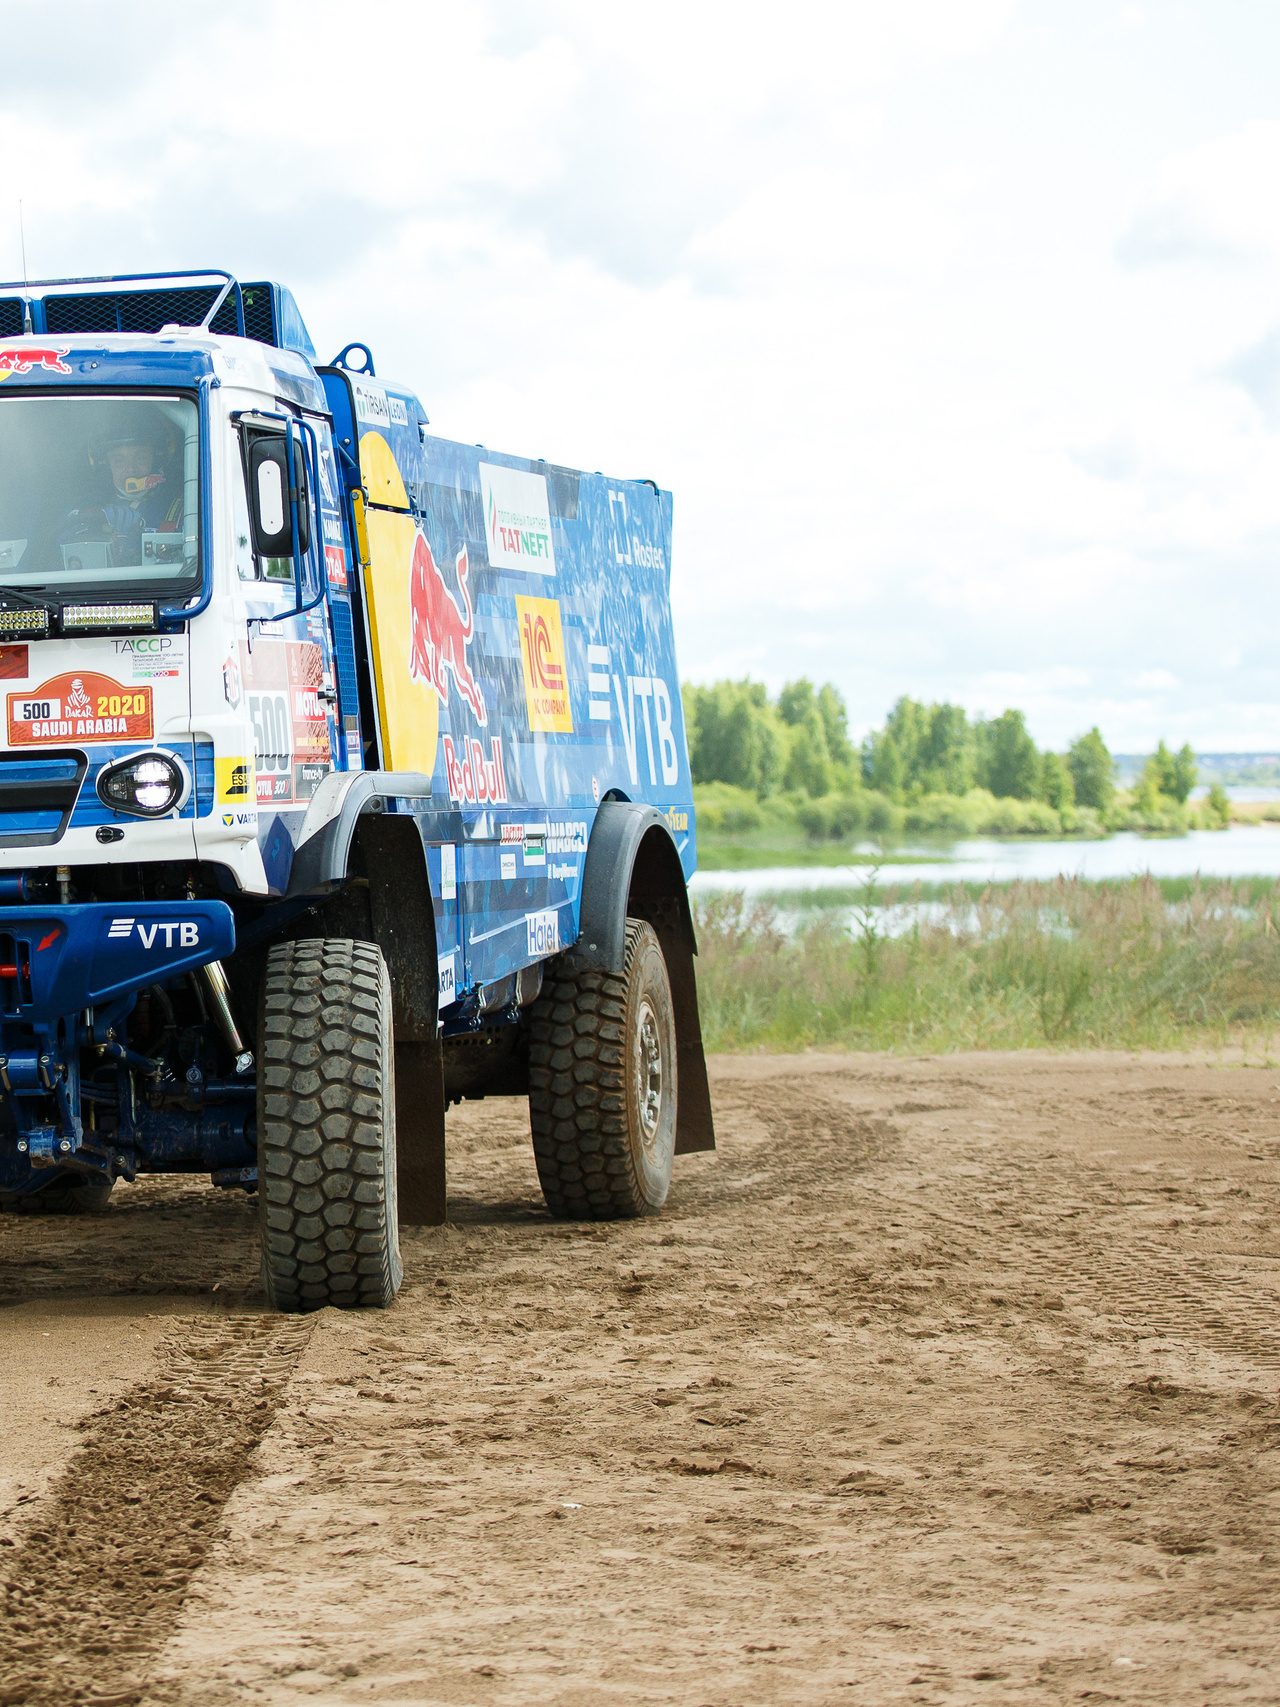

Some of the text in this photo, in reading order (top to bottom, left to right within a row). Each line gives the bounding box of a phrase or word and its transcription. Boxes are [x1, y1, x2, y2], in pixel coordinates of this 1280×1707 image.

[500, 527, 548, 558] TATNEFT
[632, 536, 666, 570] Rostec
[326, 557, 345, 578] OTAL
[23, 702, 51, 720] 500
[97, 695, 146, 717] 2020
[32, 718, 127, 737] SAUDI ARABIA
[249, 697, 290, 771] 500
[612, 674, 679, 786] VTB
[443, 736, 507, 802] Red Bull
[256, 781, 273, 796] OTUL
[546, 822, 587, 853] WABCO
[136, 922, 199, 949] VTB
[529, 915, 559, 952] Haier
[439, 968, 454, 993] RTA
